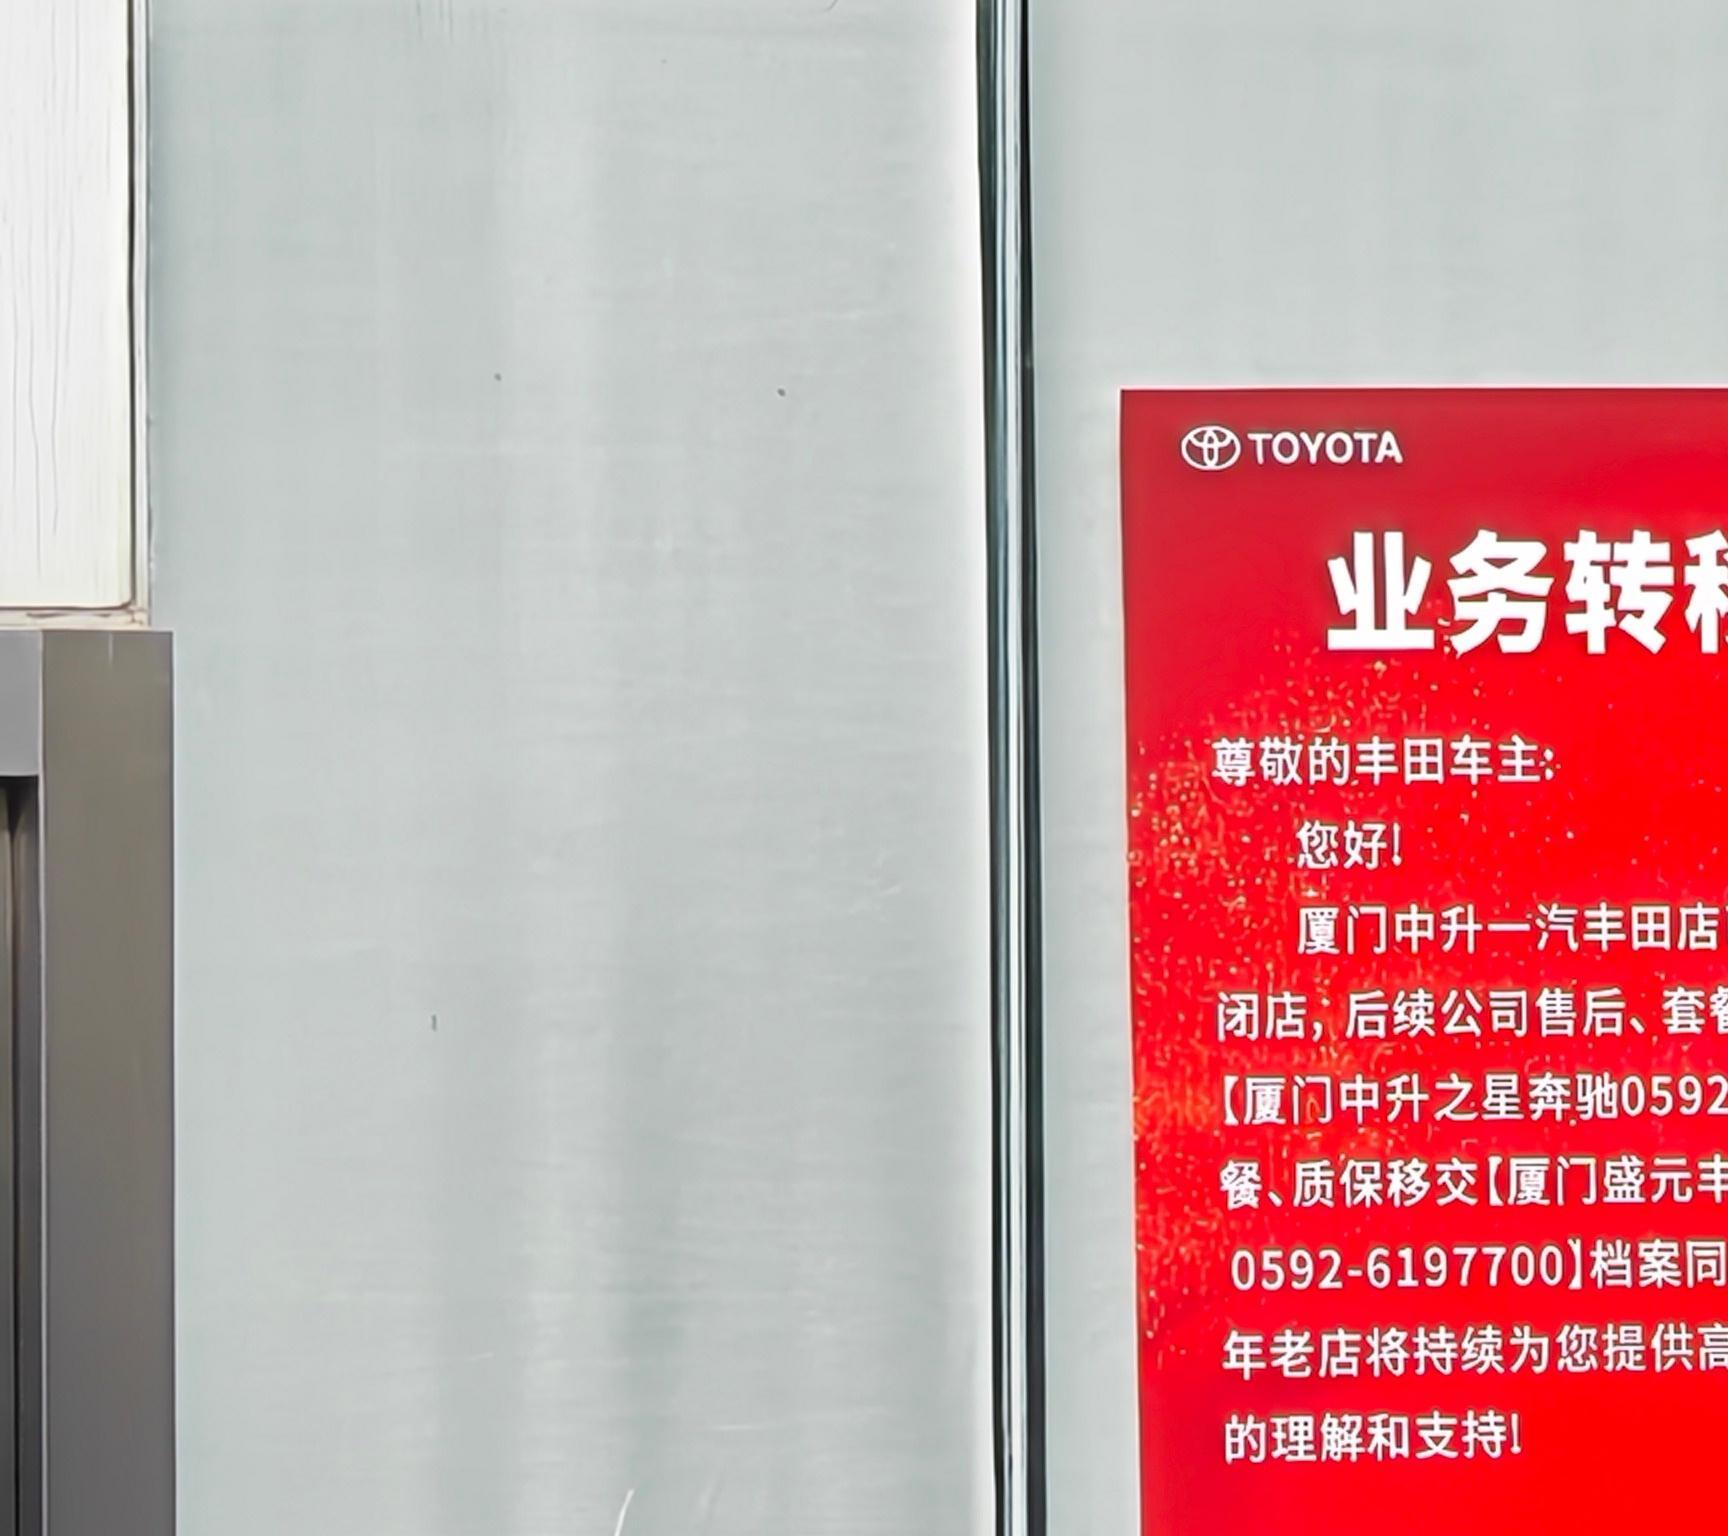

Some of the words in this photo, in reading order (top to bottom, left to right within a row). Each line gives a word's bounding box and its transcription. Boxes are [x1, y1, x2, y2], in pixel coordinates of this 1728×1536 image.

[1247, 430, 1403, 464] TOYOTA
[1211, 734, 1555, 787] 尊敬的丰田车主:
[1296, 820, 1402, 870] 您好!
[1225, 1409, 1522, 1463] 的理解和支持!
